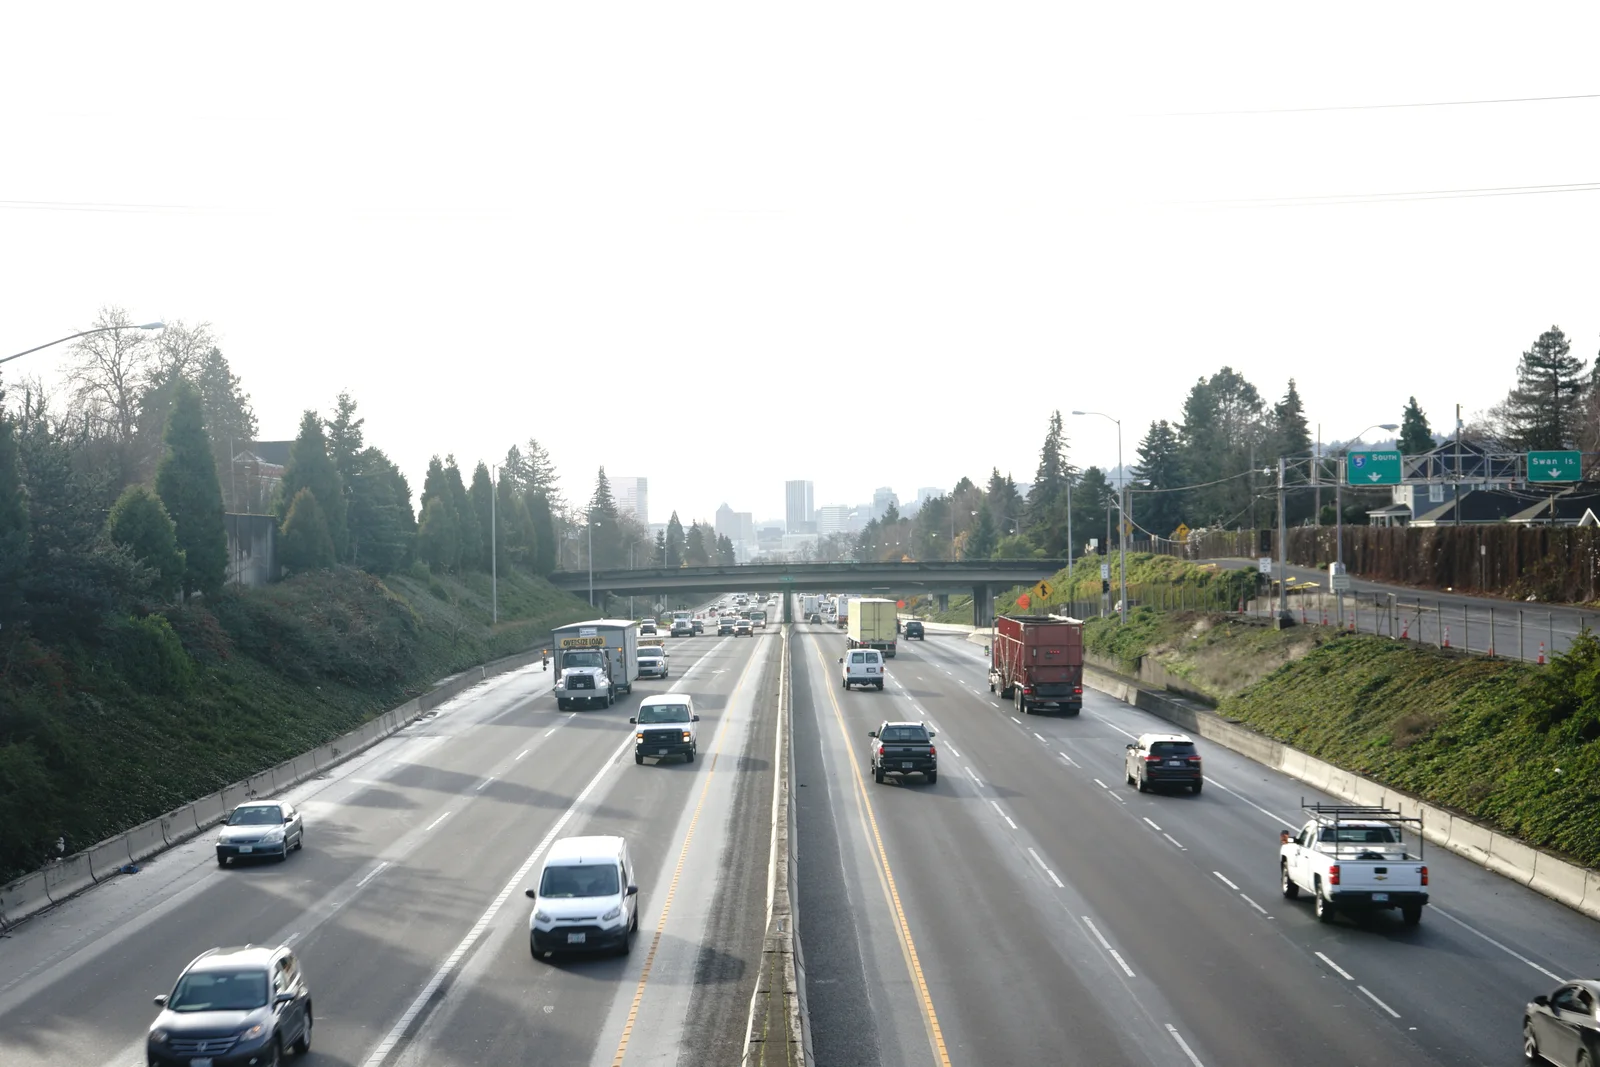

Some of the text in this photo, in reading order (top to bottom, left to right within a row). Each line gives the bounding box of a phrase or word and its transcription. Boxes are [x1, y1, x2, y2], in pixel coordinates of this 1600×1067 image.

[1356, 457, 1363, 467] 5
[1532, 457, 1576, 465] Swan Is.
[563, 637, 604, 646] OVERSIZE LOAD
